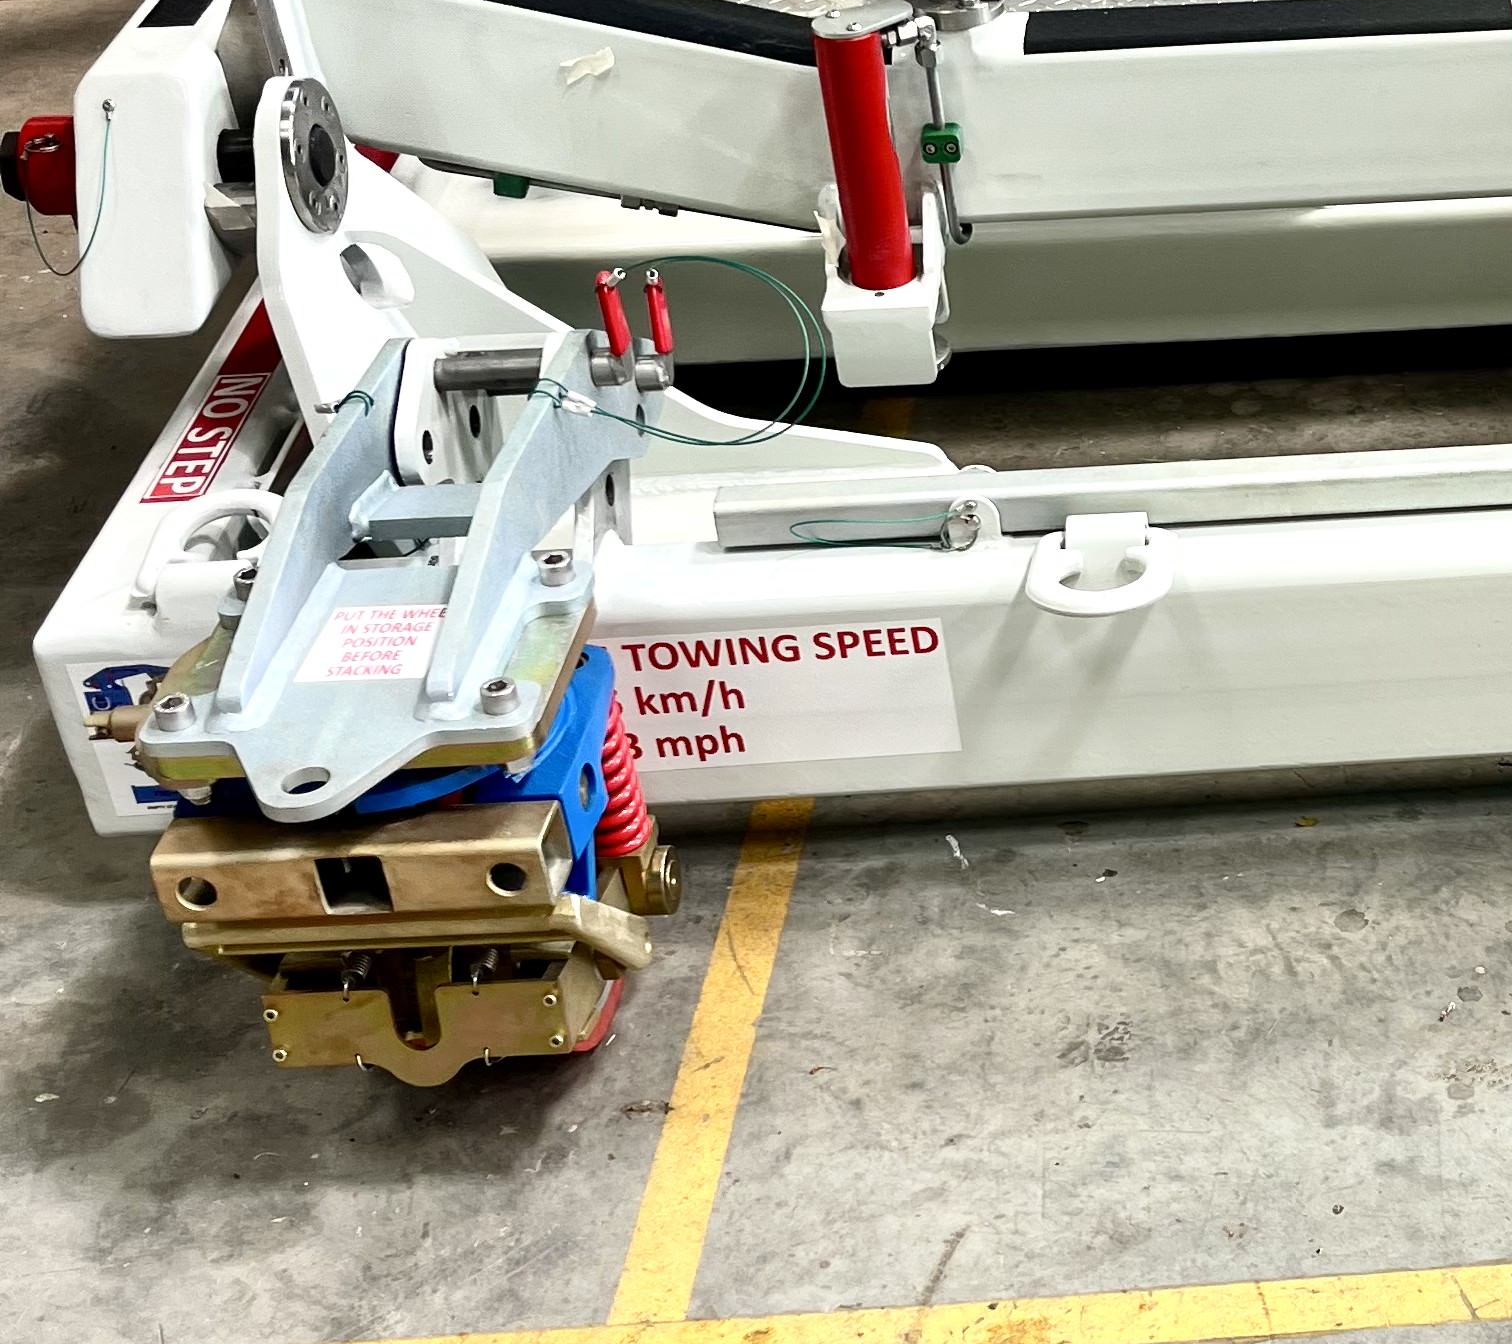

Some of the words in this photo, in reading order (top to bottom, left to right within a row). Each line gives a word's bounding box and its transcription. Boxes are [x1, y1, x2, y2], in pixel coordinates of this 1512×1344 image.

[202, 376, 264, 418] NO
[159, 426, 233, 494] STEP
[334, 610, 364, 621] PUT
[371, 609, 397, 620] THE
[340, 624, 358, 635] IN
[363, 622, 434, 634] STORAGE
[342, 635, 419, 648] POSITION
[621, 635, 802, 672] TOWING
[813, 626, 940, 661] SPEED
[341, 650, 404, 663] BEFORE
[325, 663, 404, 677] STACKING
[634, 680, 745, 717] km/h
[655, 725, 746, 761] mph
